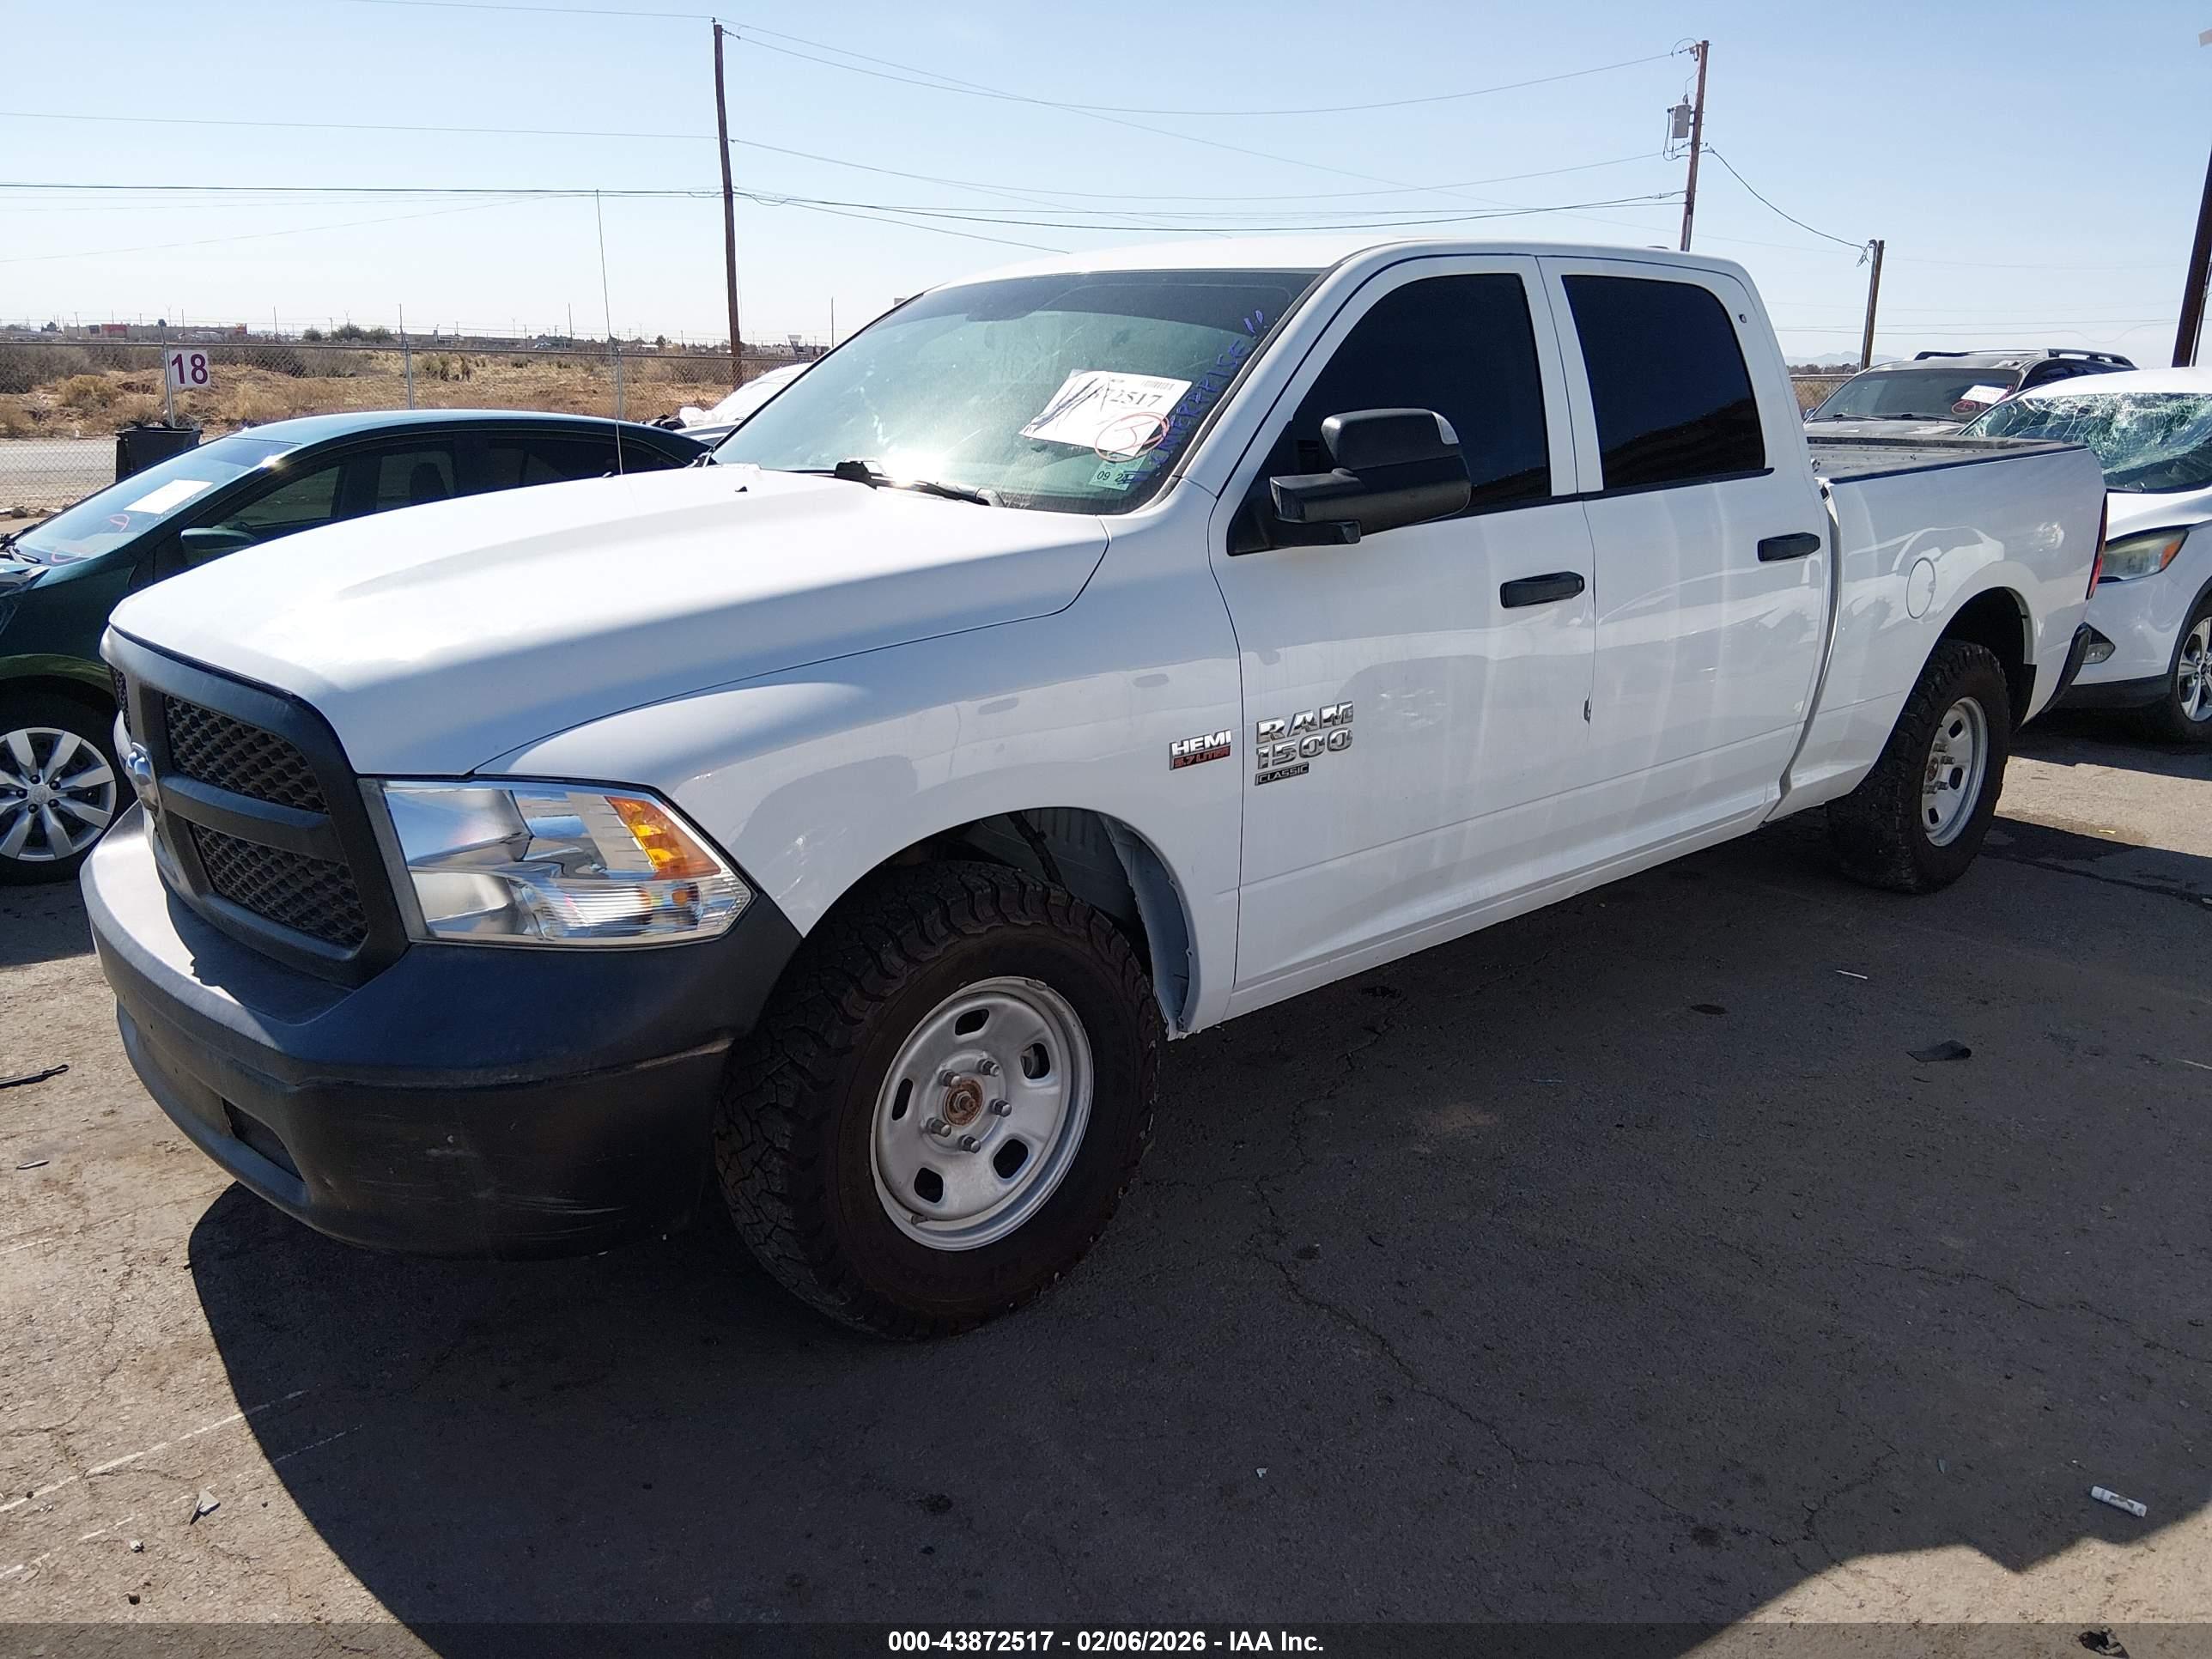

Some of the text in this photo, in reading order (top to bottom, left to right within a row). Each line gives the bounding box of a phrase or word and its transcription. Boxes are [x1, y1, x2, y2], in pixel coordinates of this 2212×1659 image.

[171, 353, 208, 385] 18
[1097, 470, 1111, 481] 09
[1256, 701, 1354, 744] RAM
[1170, 729, 1231, 756] HEMI
[1256, 727, 1353, 769] 1500
[1258, 763, 1309, 784] CLASSIC
